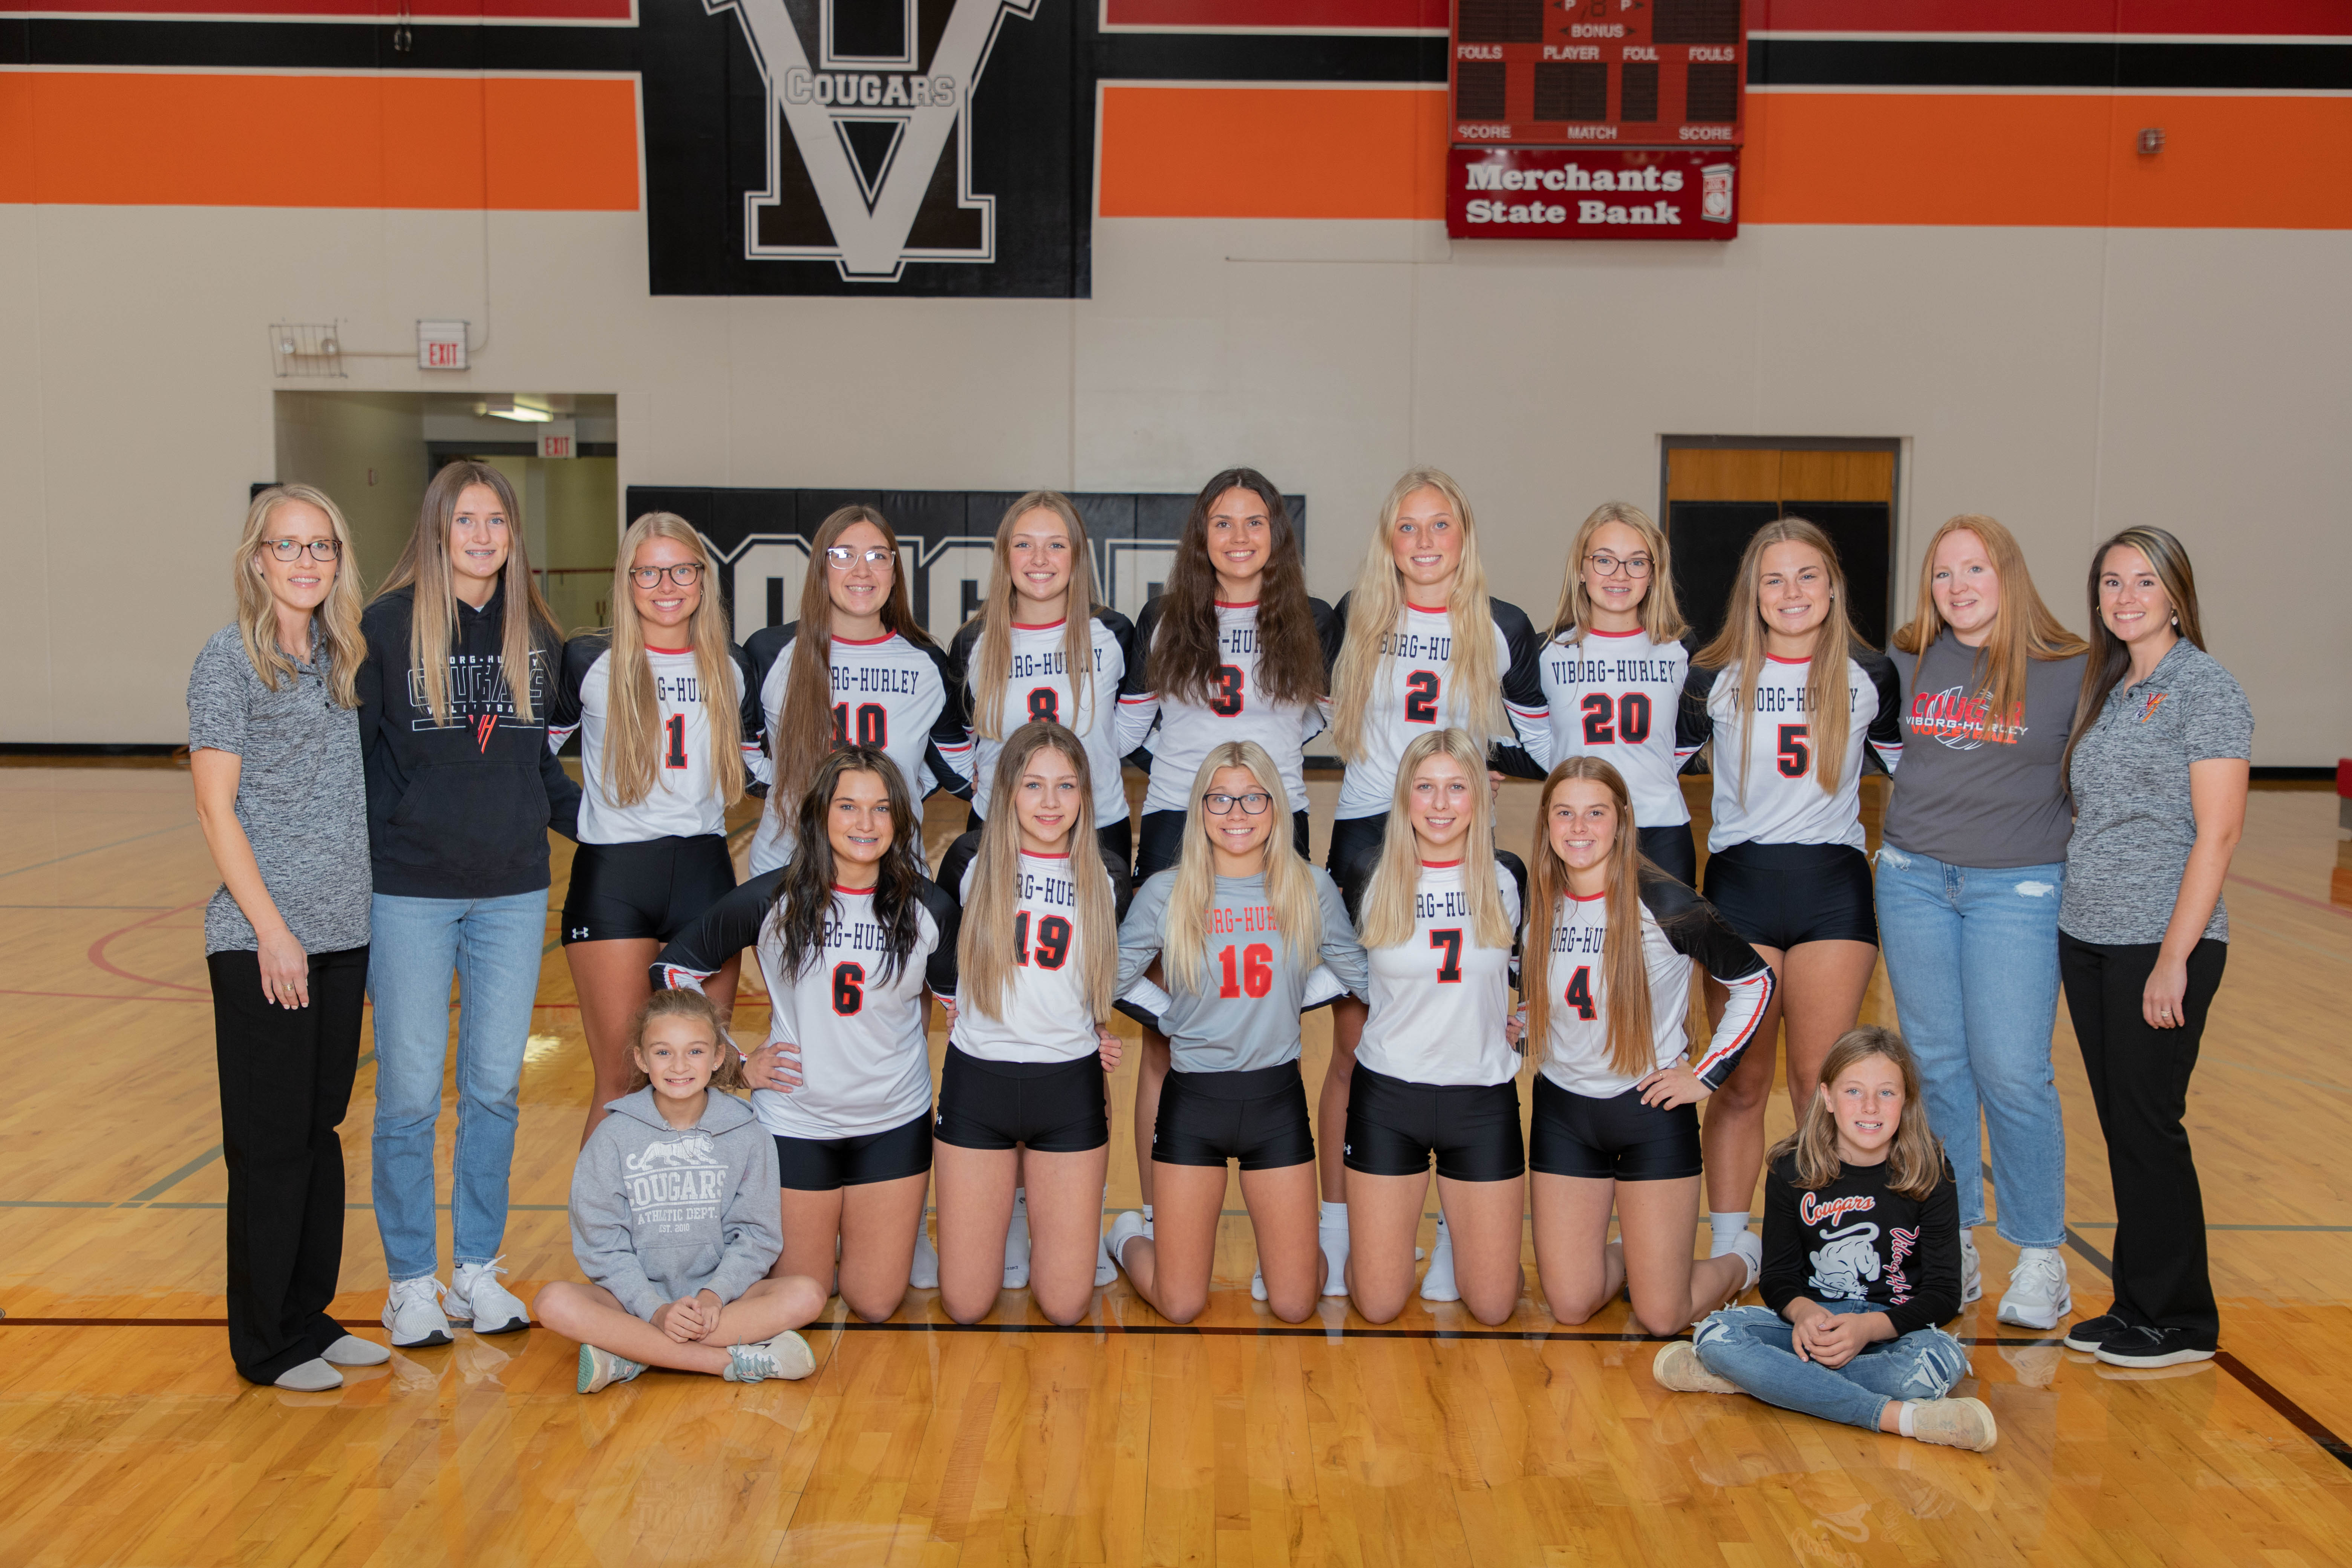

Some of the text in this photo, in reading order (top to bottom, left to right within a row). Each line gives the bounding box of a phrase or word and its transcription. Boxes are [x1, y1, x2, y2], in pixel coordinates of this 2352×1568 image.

[1571, 23, 1624, 38] BONUS
[1458, 46, 1734, 61] FOULS PLAYER FOUL FOULS
[785, 67, 956, 107] COUGARS
[1458, 126, 1733, 141] SCORE MATCH SCORE
[1465, 163, 1684, 192] Merchants
[1465, 199, 1682, 225] State Bank
[429, 341, 459, 367] EXIT
[544, 435, 570, 457] EXIT
[1210, 665, 1244, 718] 3
[1551, 660, 1675, 685] VIBORG-HURLEY
[1027, 686, 1059, 724] 8
[1404, 669, 1441, 724] 2
[829, 701, 888, 753] 10
[1580, 692, 1652, 746] 20
[665, 713, 688, 769] 1
[1777, 724, 1810, 779] 5
[1012, 910, 1073, 971] 19
[1429, 928, 1463, 984] 7
[832, 961, 865, 1017] 6
[1218, 943, 1273, 999] 16
[1564, 965, 1598, 1021] 4
[637, 1207, 718, 1225] ATHLETIC DEPT.
[659, 1223, 690, 1233] EST. 2010
[1800, 1191, 1875, 1227] Cougars
